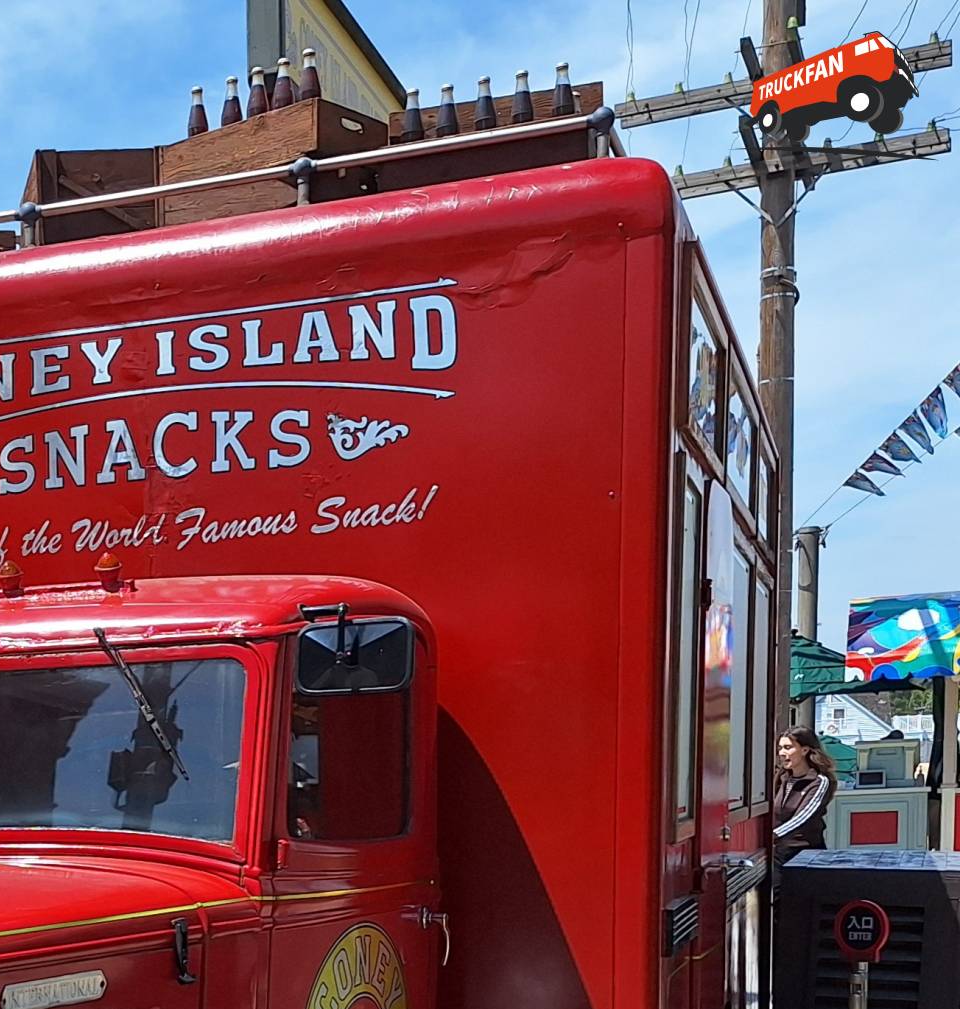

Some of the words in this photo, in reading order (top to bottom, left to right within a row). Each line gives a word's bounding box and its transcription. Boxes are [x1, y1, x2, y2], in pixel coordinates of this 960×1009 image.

[155, 295, 458, 377] ISLAND
[21, 520, 63, 556] the
[71, 513, 165, 551] World
[175, 507, 298, 551] Famous
[309, 485, 441, 535] Snack!
[847, 915, 873, 929] 入口
